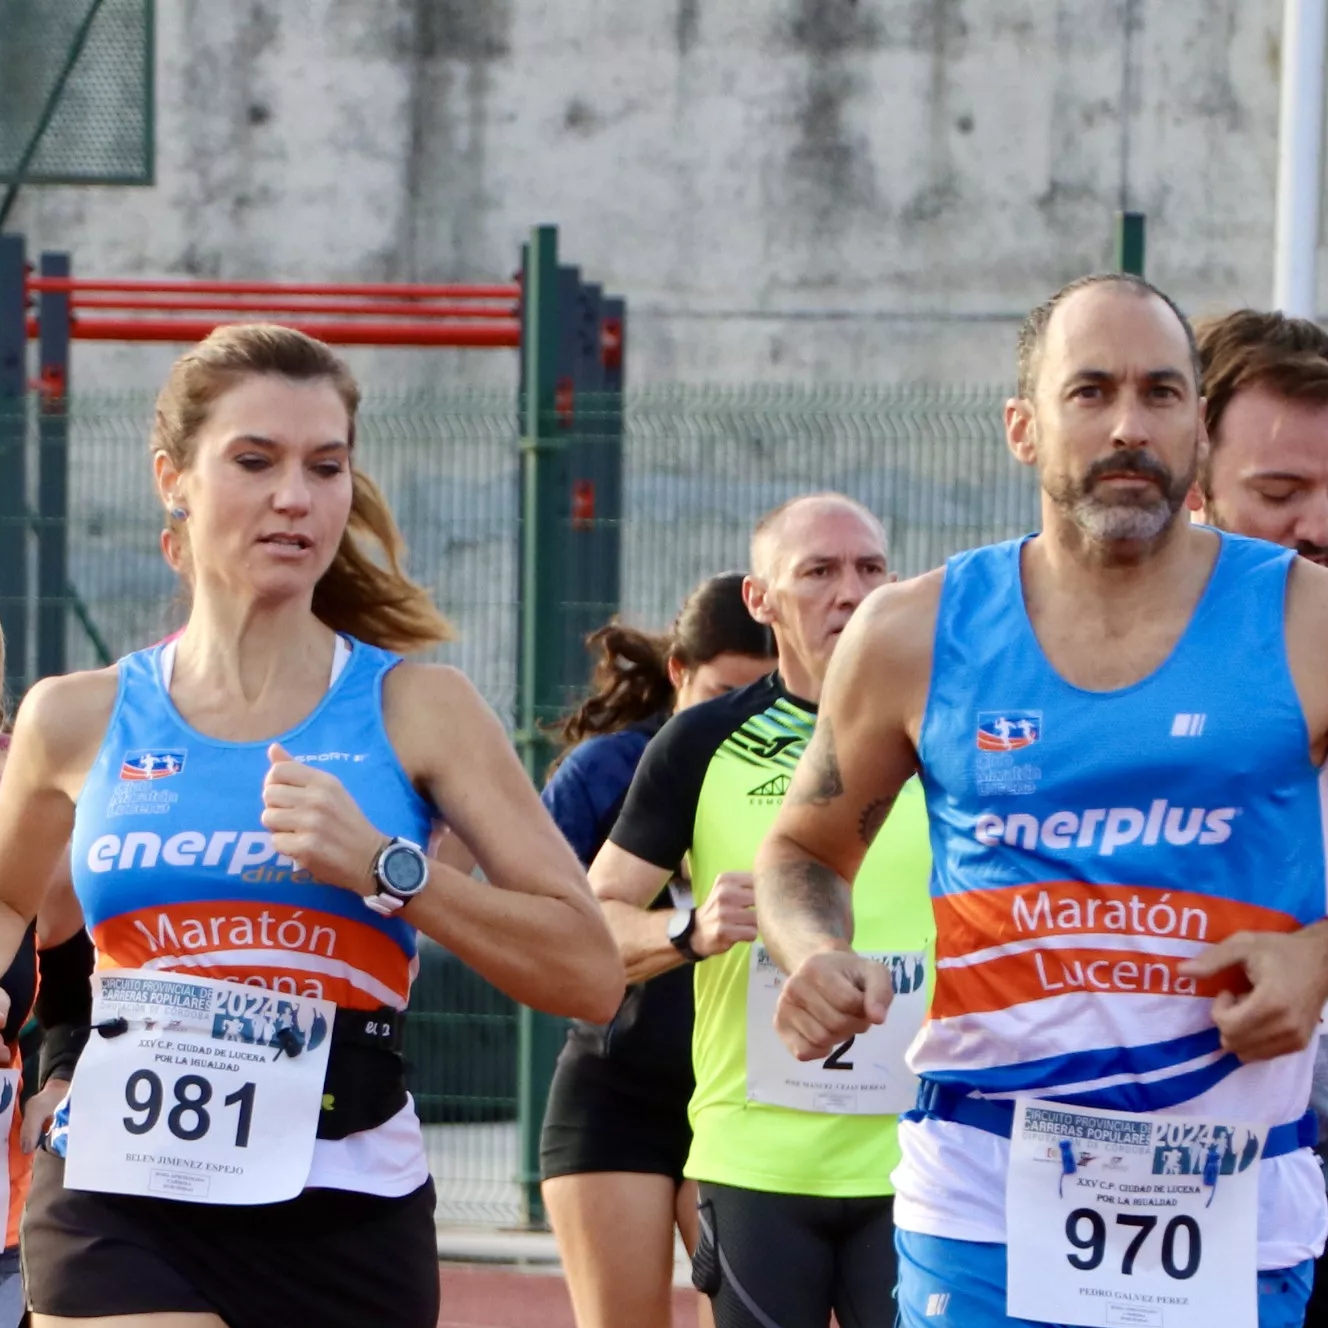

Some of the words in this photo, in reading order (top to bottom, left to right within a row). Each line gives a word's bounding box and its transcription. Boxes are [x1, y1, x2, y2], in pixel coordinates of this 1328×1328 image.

[975, 799, 1236, 855] enerplus
[242, 865, 317, 884] dire
[1012, 891, 1208, 939] Maratón
[135, 910, 338, 956] Maratón
[101, 978, 140, 989] CIRCUITO
[143, 981, 196, 998] PROVINCIAL
[200, 988, 212, 999] DE
[101, 989, 149, 1003] CARRERAS
[151, 993, 212, 1010] POPULARES
[215, 990, 277, 1021] 2024
[138, 1040, 156, 1048] XXV
[158, 1041, 174, 1050] C.P.
[177, 1043, 212, 1055] CIUDAD
[214, 1048, 226, 1057] DE
[229, 1050, 266, 1063] LUCENA
[155, 1054, 172, 1064] POR
[175, 1056, 188, 1065] LA
[191, 1058, 240, 1072] IGUALDAD
[122, 1068, 256, 1148] 981
[1026, 1109, 1072, 1124] CIRCUITO
[1076, 1116, 1136, 1132] PROVINCIAL
[1024, 1120, 1083, 1136] CARRERAS
[1087, 1128, 1151, 1145] POPULARES
[1156, 1123, 1212, 1148] 2024
[125, 1153, 154, 1163] BELEN
[157, 1156, 203, 1170] JIMENEZ
[205, 1161, 244, 1175] ESPEJO
[1077, 1178, 1097, 1187] XXV
[1119, 1184, 1152, 1193] CIUDAD
[1154, 1185, 1165, 1193] DE
[1167, 1186, 1201, 1194] LUCENA
[1096, 1194, 1114, 1203] POR
[1117, 1196, 1130, 1204] LA
[1133, 1197, 1177, 1206] IGUALDAD
[1065, 1207, 1202, 1280] 970
[1079, 1288, 1112, 1297] PEDRO
[1114, 1292, 1153, 1302] GALVEZ
[1156, 1296, 1189, 1304] PEREZ
